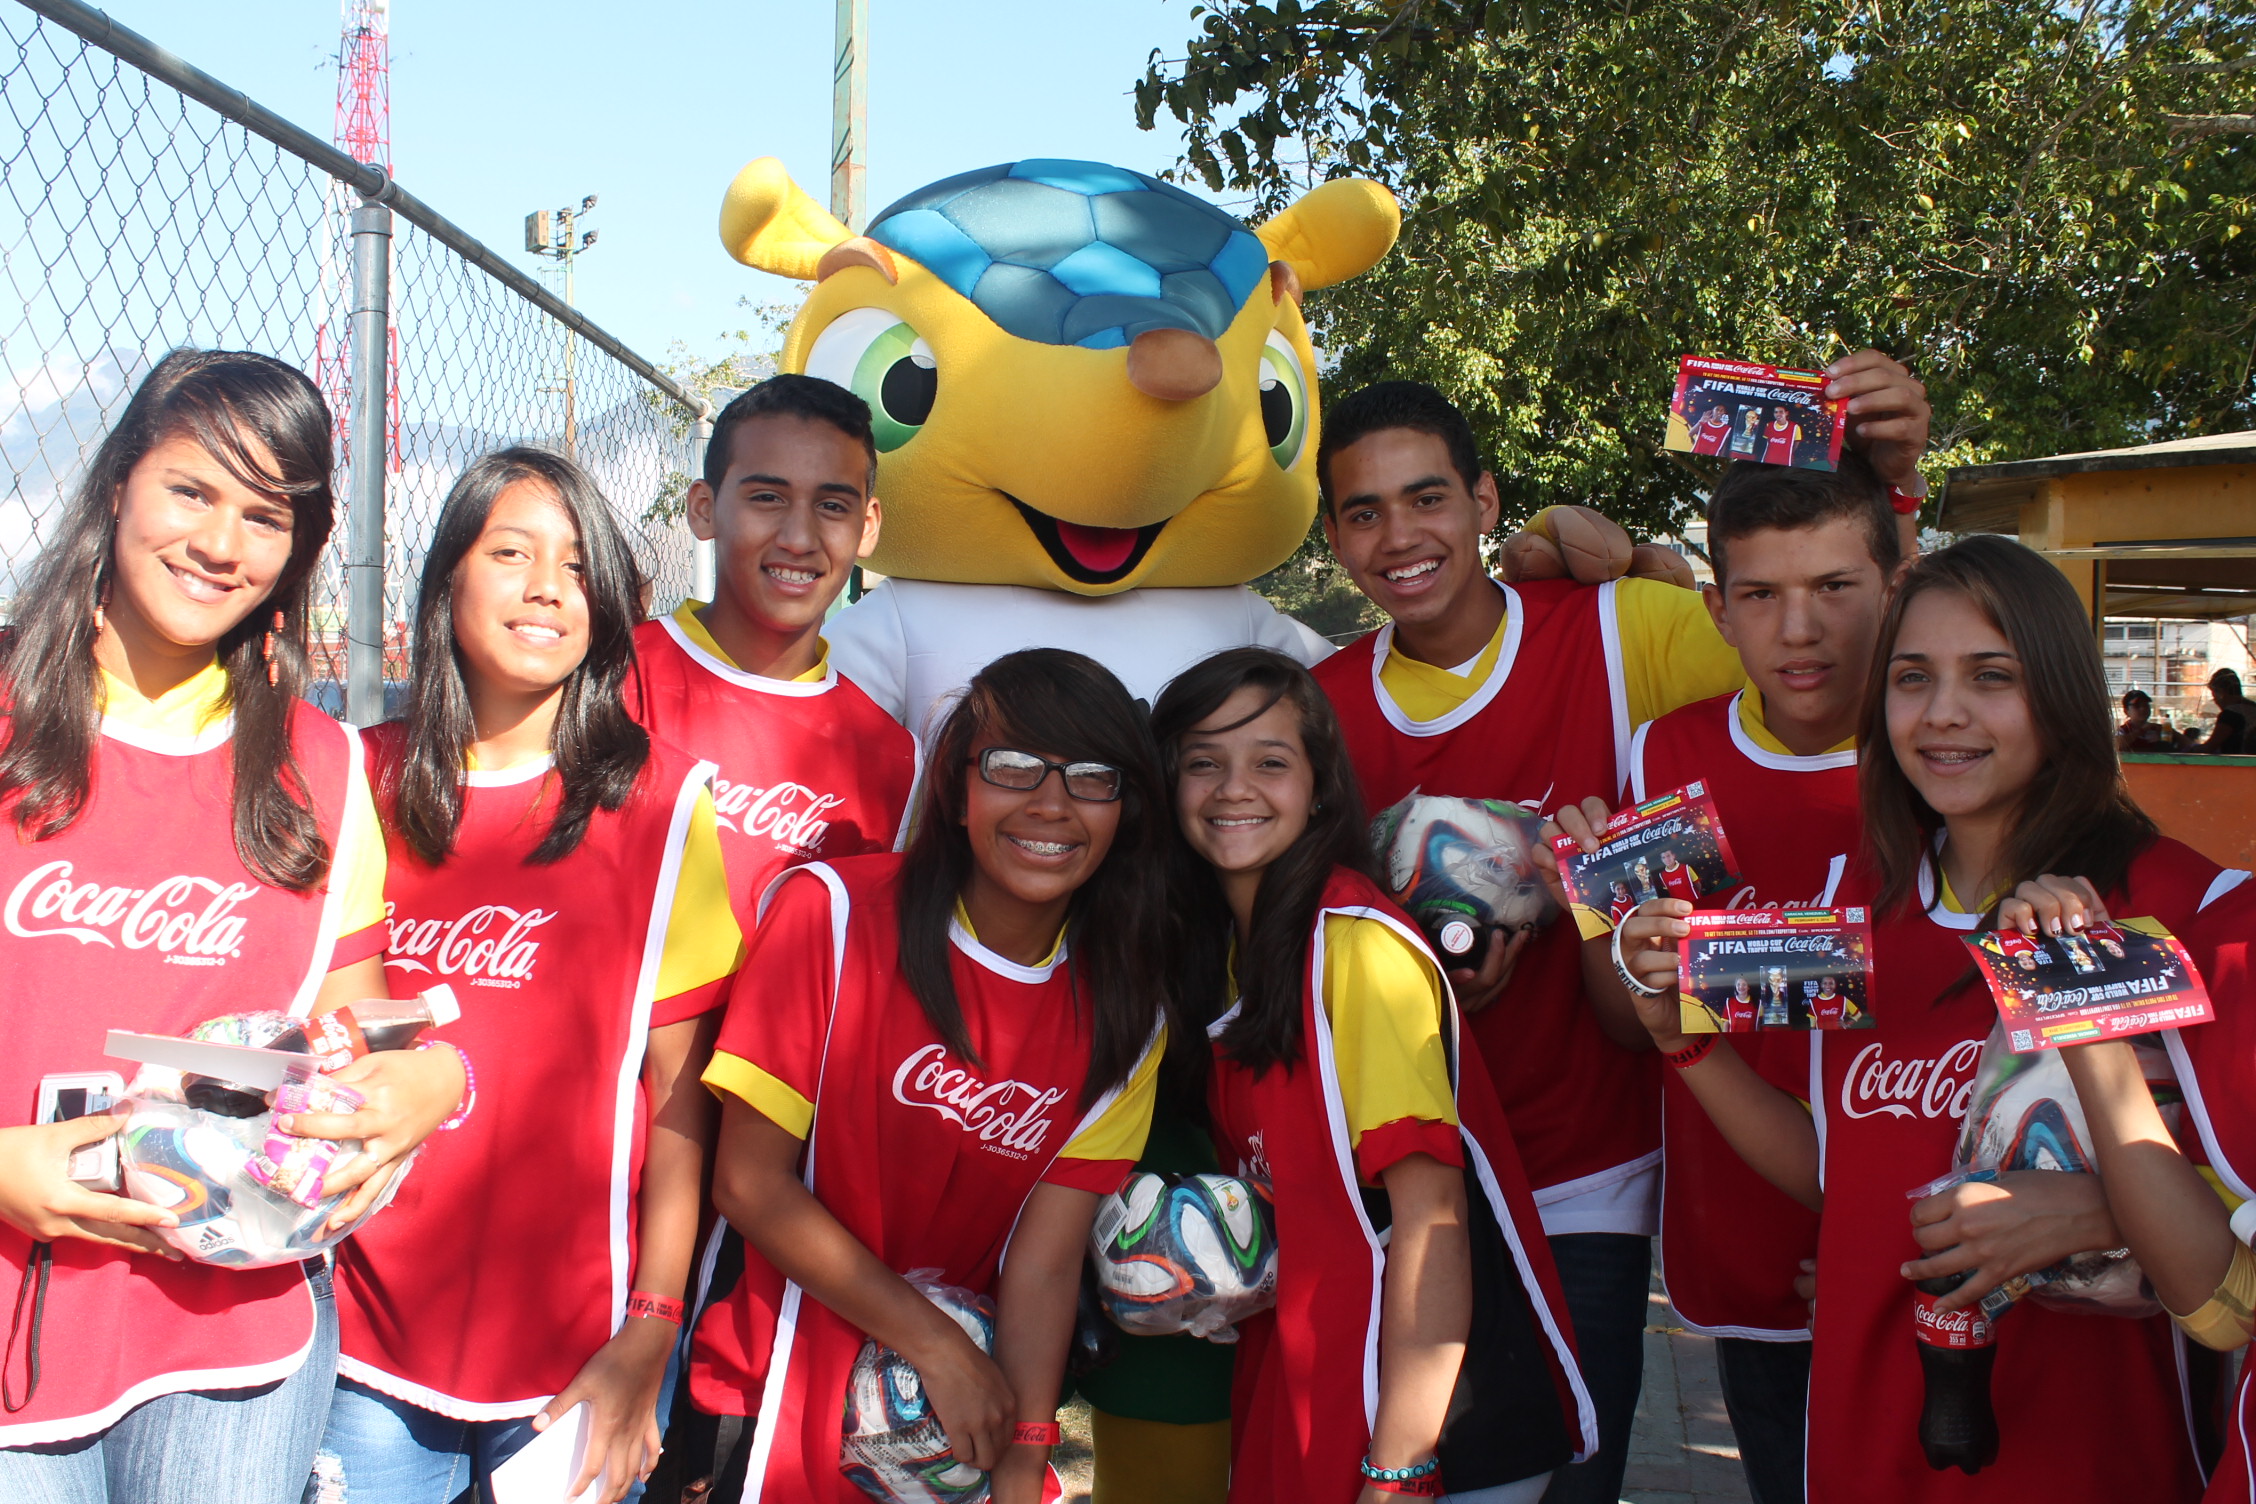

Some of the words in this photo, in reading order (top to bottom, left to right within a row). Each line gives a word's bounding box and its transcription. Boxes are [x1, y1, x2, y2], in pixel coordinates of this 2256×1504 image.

[1686, 359, 1711, 369] FIFA
[1702, 379, 1735, 394] FIFA
[1767, 388, 1814, 405] Coca-Cola
[714, 774, 846, 851] ca-Cola
[1556, 836, 1576, 848] FIF
[1582, 846, 1613, 866] FIFA
[1611, 838, 1628, 850] WORLD
[1628, 834, 1640, 842] CUP
[1642, 816, 1682, 844] Coca-Cola
[4, 860, 259, 957] Coca-Cola
[1736, 912, 1772, 925] Coca-Cola
[383, 901, 558, 980] ca-Cola
[1708, 940, 1746, 954] FIFA
[1784, 935, 1836, 952] Coca-Cola
[2087, 985, 2104, 994] TOUR
[2104, 982, 2126, 990] TROPHY
[2126, 976, 2168, 994] FIFA
[2036, 987, 2088, 1013] Coca-Cola
[2090, 992, 2104, 1002] CUP
[2104, 990, 2129, 1000] WORLD
[2176, 1004, 2205, 1020] FIFA
[2110, 1013, 2148, 1032] Coca-Cola
[1841, 1039, 1985, 1120] Coca-Co
[892, 1043, 1069, 1153] Coca-Cola
[980, 1143, 1028, 1161] J-30365312-0
[199, 1236, 235, 1251] adidas
[630, 1298, 655, 1312] IFA
[1916, 1304, 1972, 1332] CocaCola
